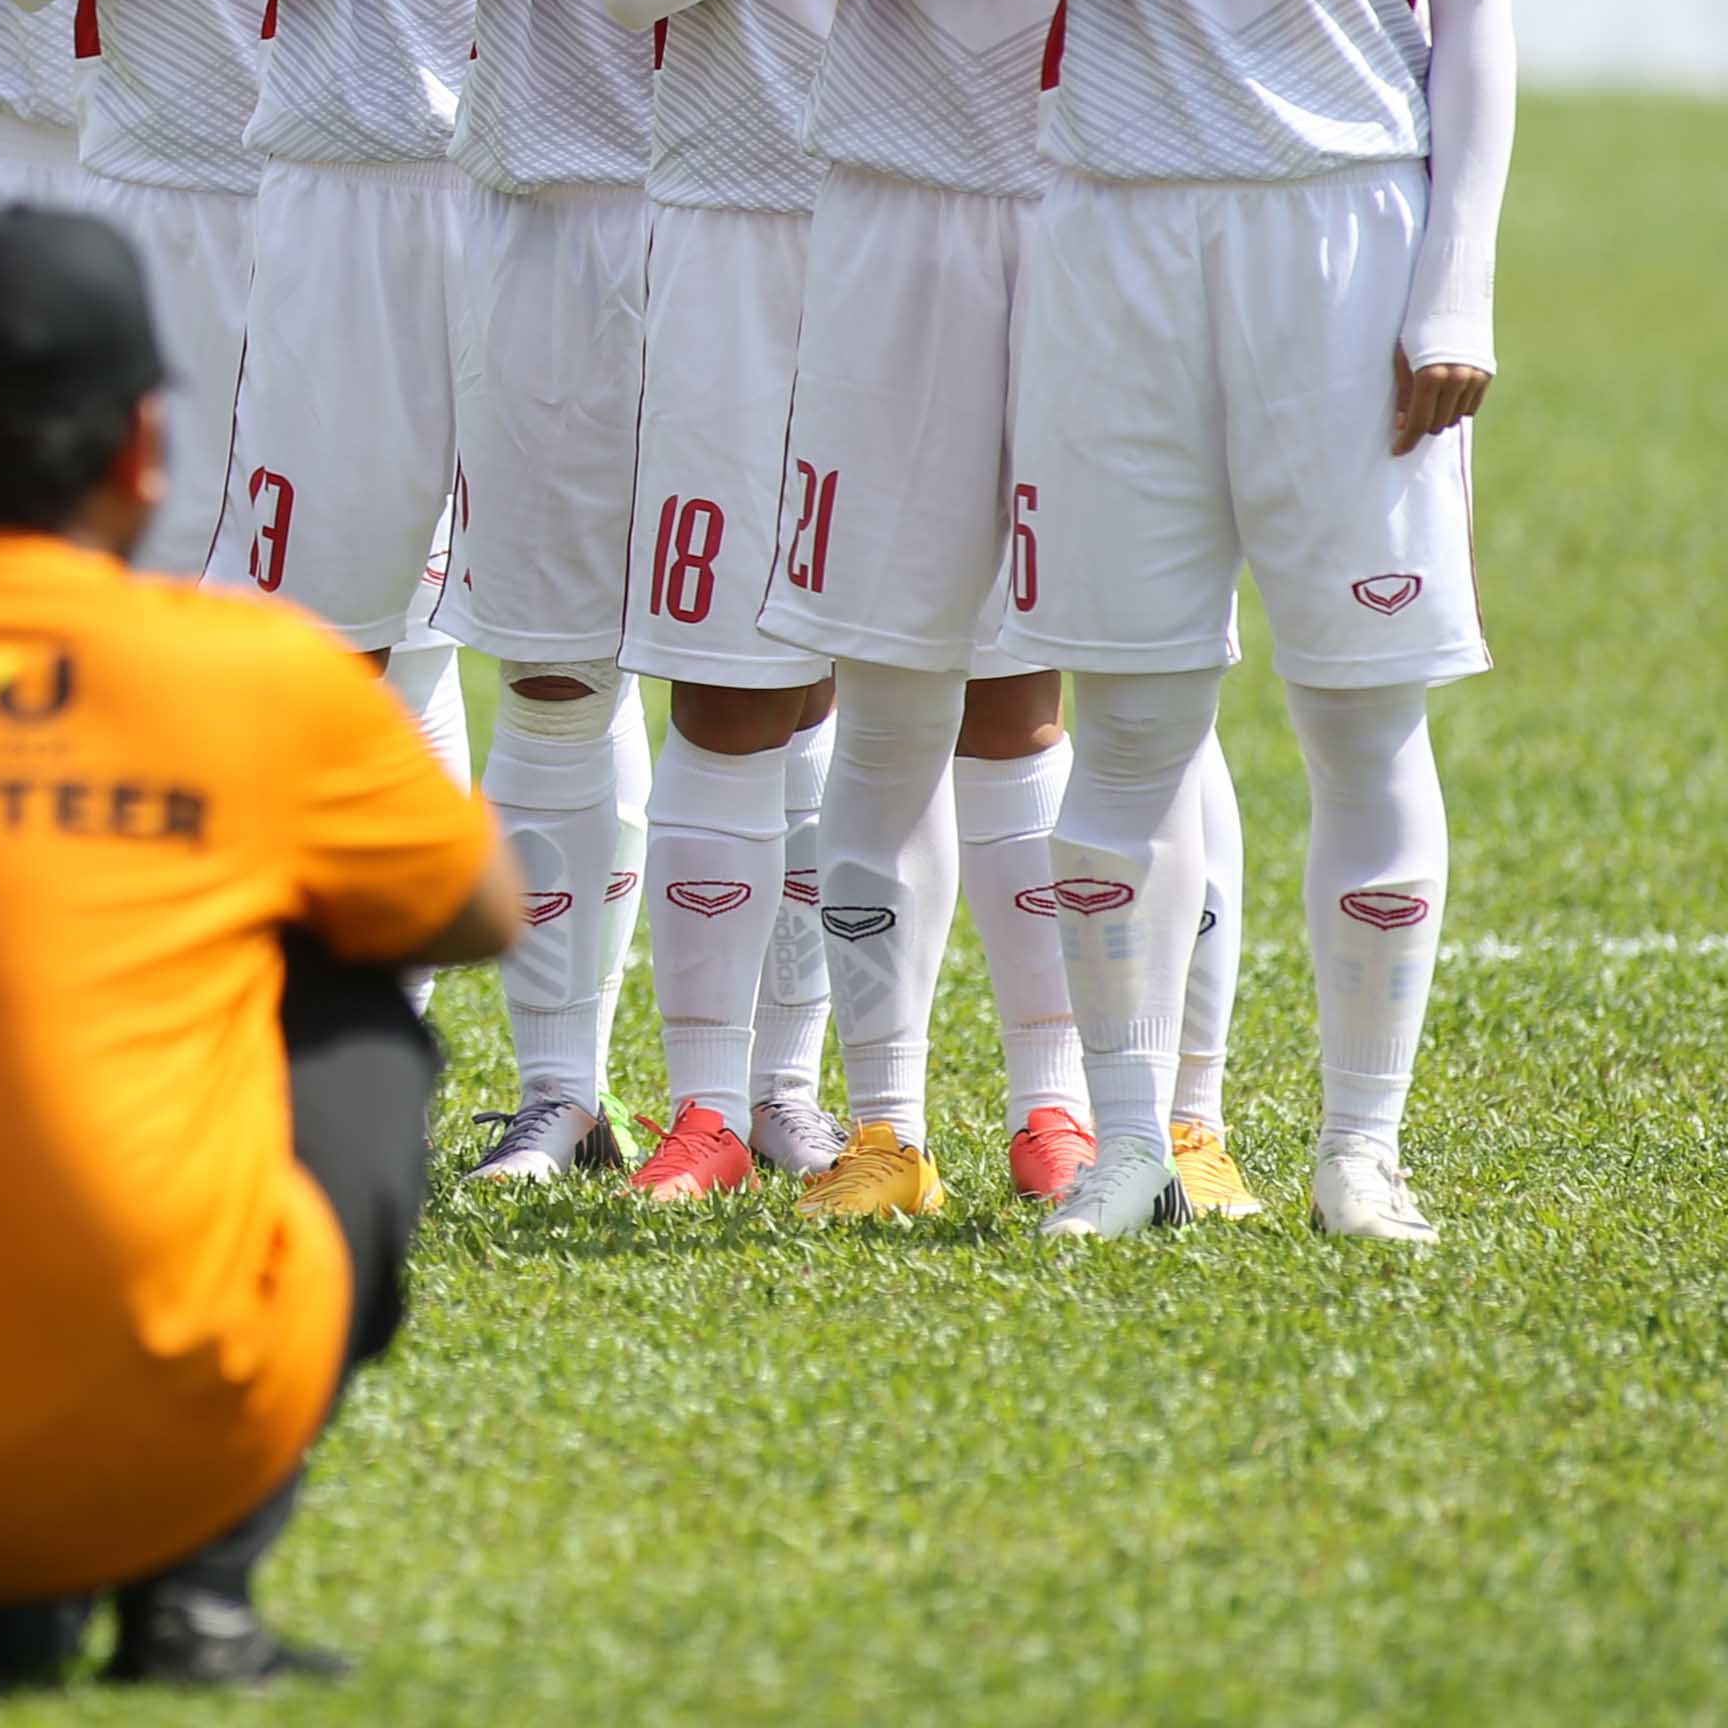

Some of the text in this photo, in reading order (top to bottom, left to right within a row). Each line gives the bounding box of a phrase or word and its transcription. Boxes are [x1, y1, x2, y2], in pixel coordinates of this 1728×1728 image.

[650, 494, 726, 624] 18
[789, 458, 839, 594] 21
[1013, 483, 1038, 613] 6
